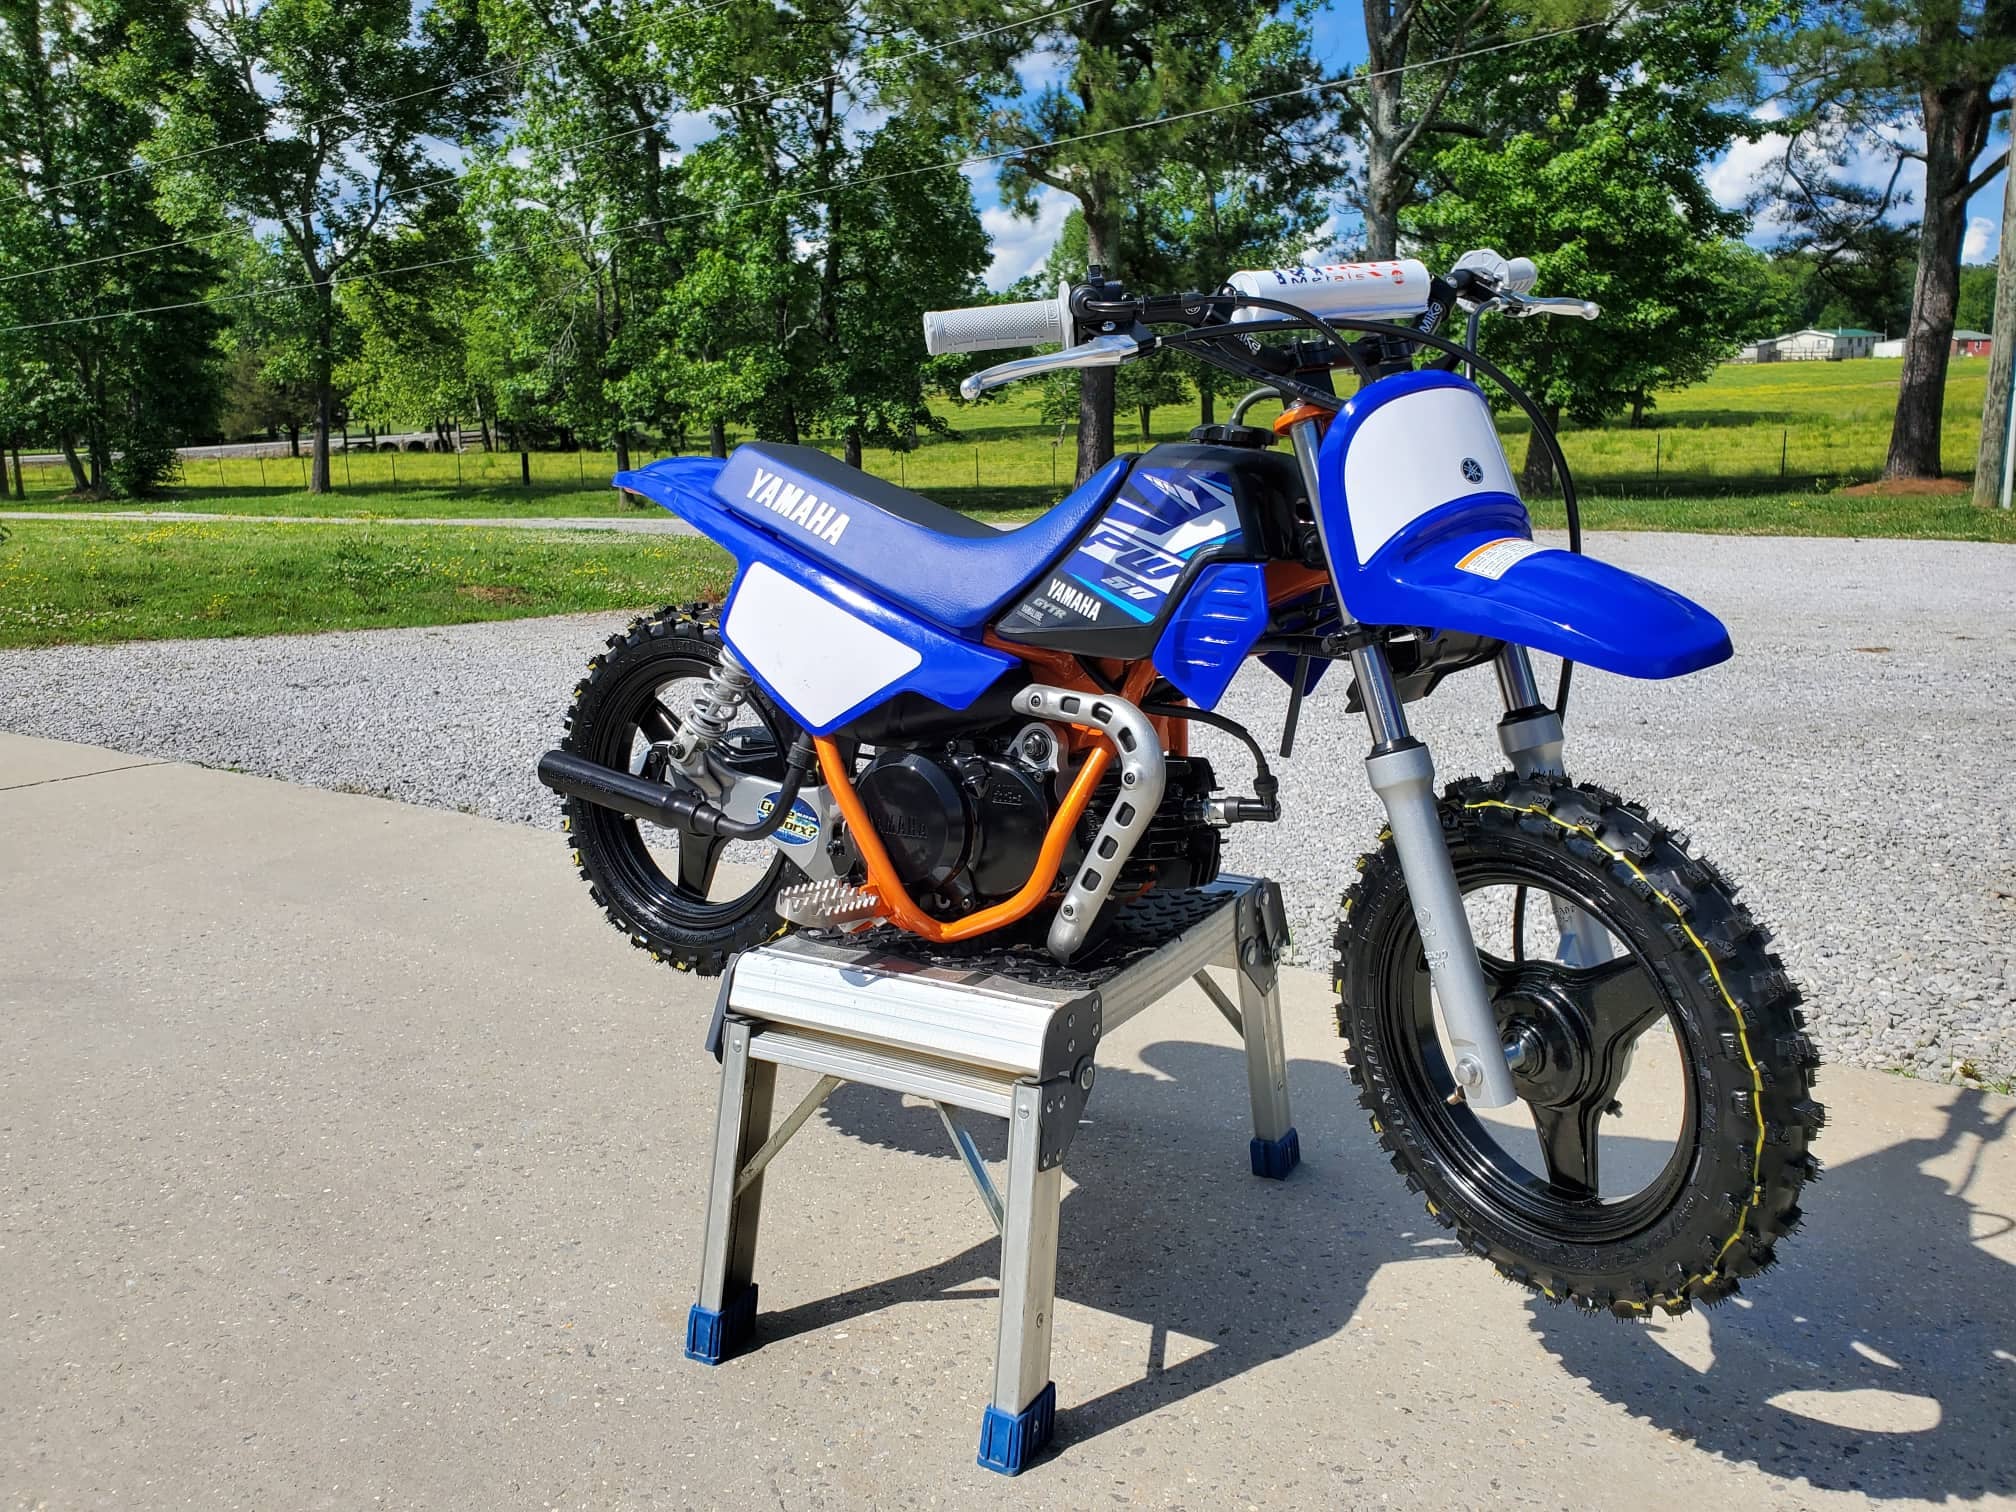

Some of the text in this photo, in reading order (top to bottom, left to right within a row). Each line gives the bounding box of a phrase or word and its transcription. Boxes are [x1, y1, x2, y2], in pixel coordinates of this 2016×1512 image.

[746, 467, 850, 546] YAMAHA
[1047, 578, 1102, 622] YAMAHA
[1100, 575, 1158, 600] 50
[1032, 597, 1067, 620] GYTR
